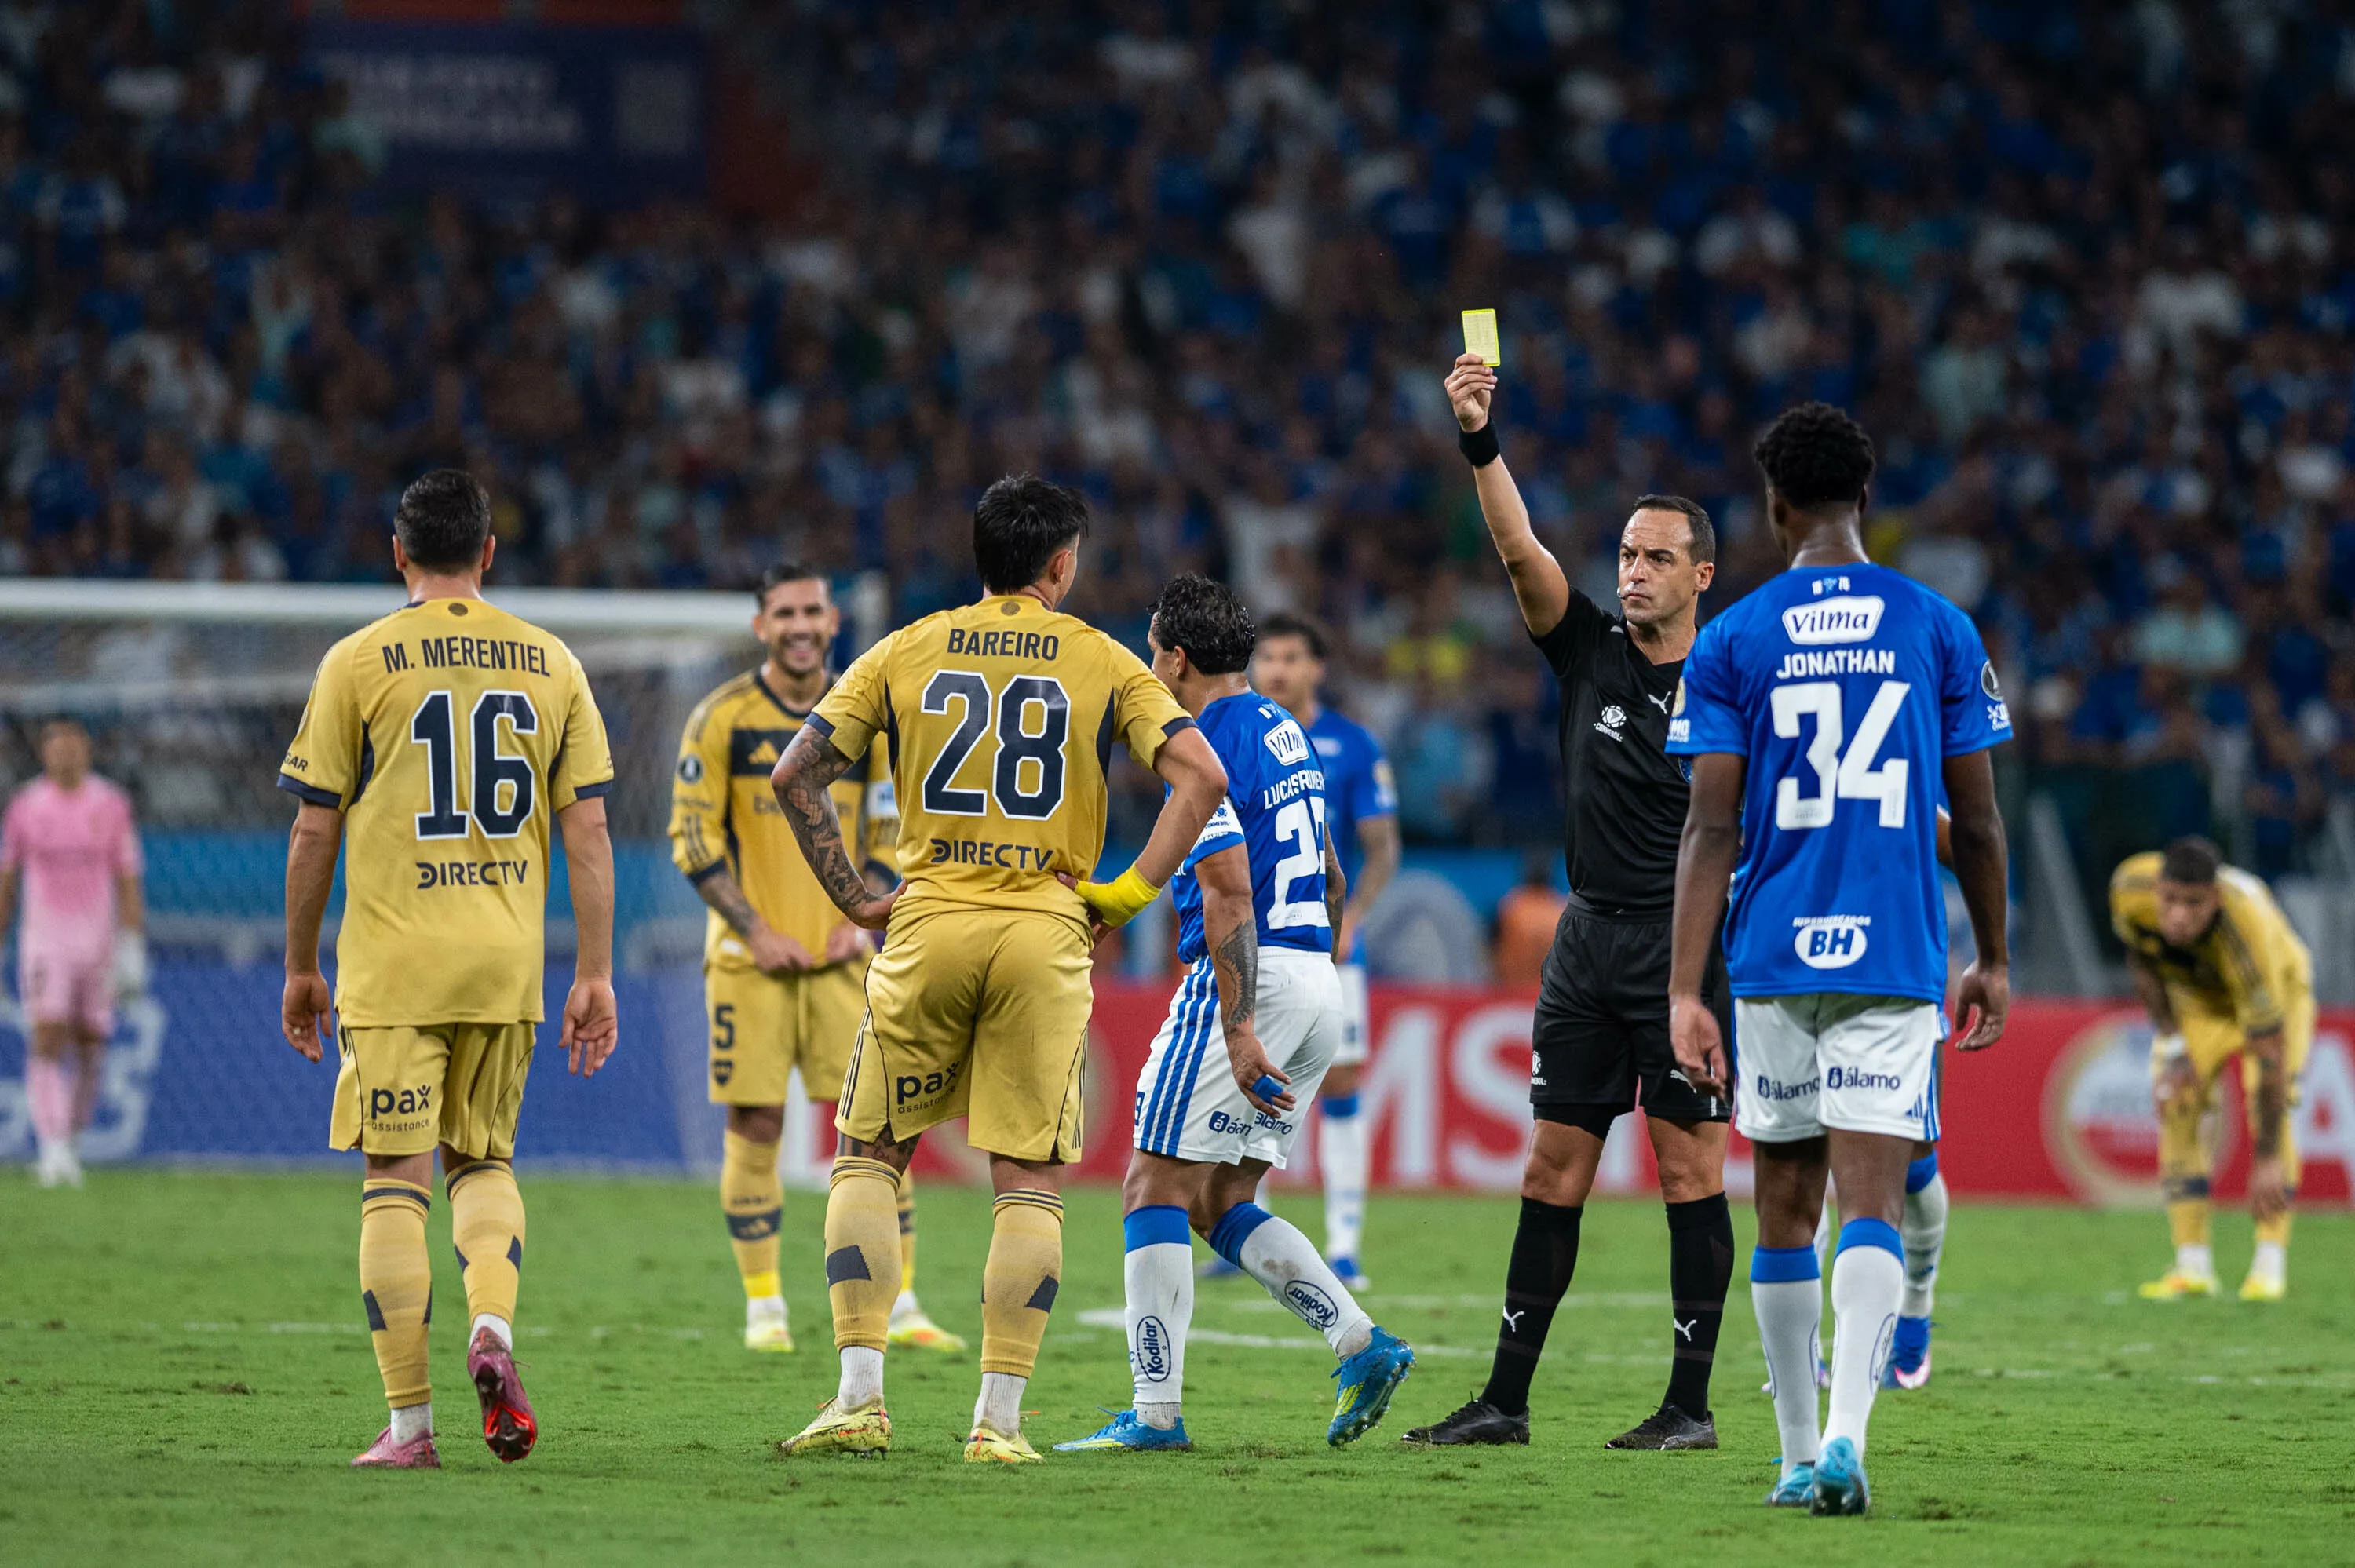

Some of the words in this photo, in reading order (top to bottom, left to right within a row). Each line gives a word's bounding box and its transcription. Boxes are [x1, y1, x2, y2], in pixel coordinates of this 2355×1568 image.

[1792, 610, 1869, 634] Vilma
[382, 642, 415, 674] M.
[422, 636, 551, 677] MERENTIEL
[947, 628, 1059, 661] BAREIRO
[1776, 648, 1896, 680] JONATHAN
[921, 669, 1072, 822] 28
[1769, 680, 1911, 831] 34
[411, 689, 539, 841] 16
[930, 838, 1054, 871] DIRECTV
[415, 860, 528, 889] DIRECTV
[1809, 928, 1855, 957] BH
[715, 1003, 735, 1049] 5
[371, 1084, 431, 1120] pax
[1143, 1321, 1165, 1374] Kodilar
